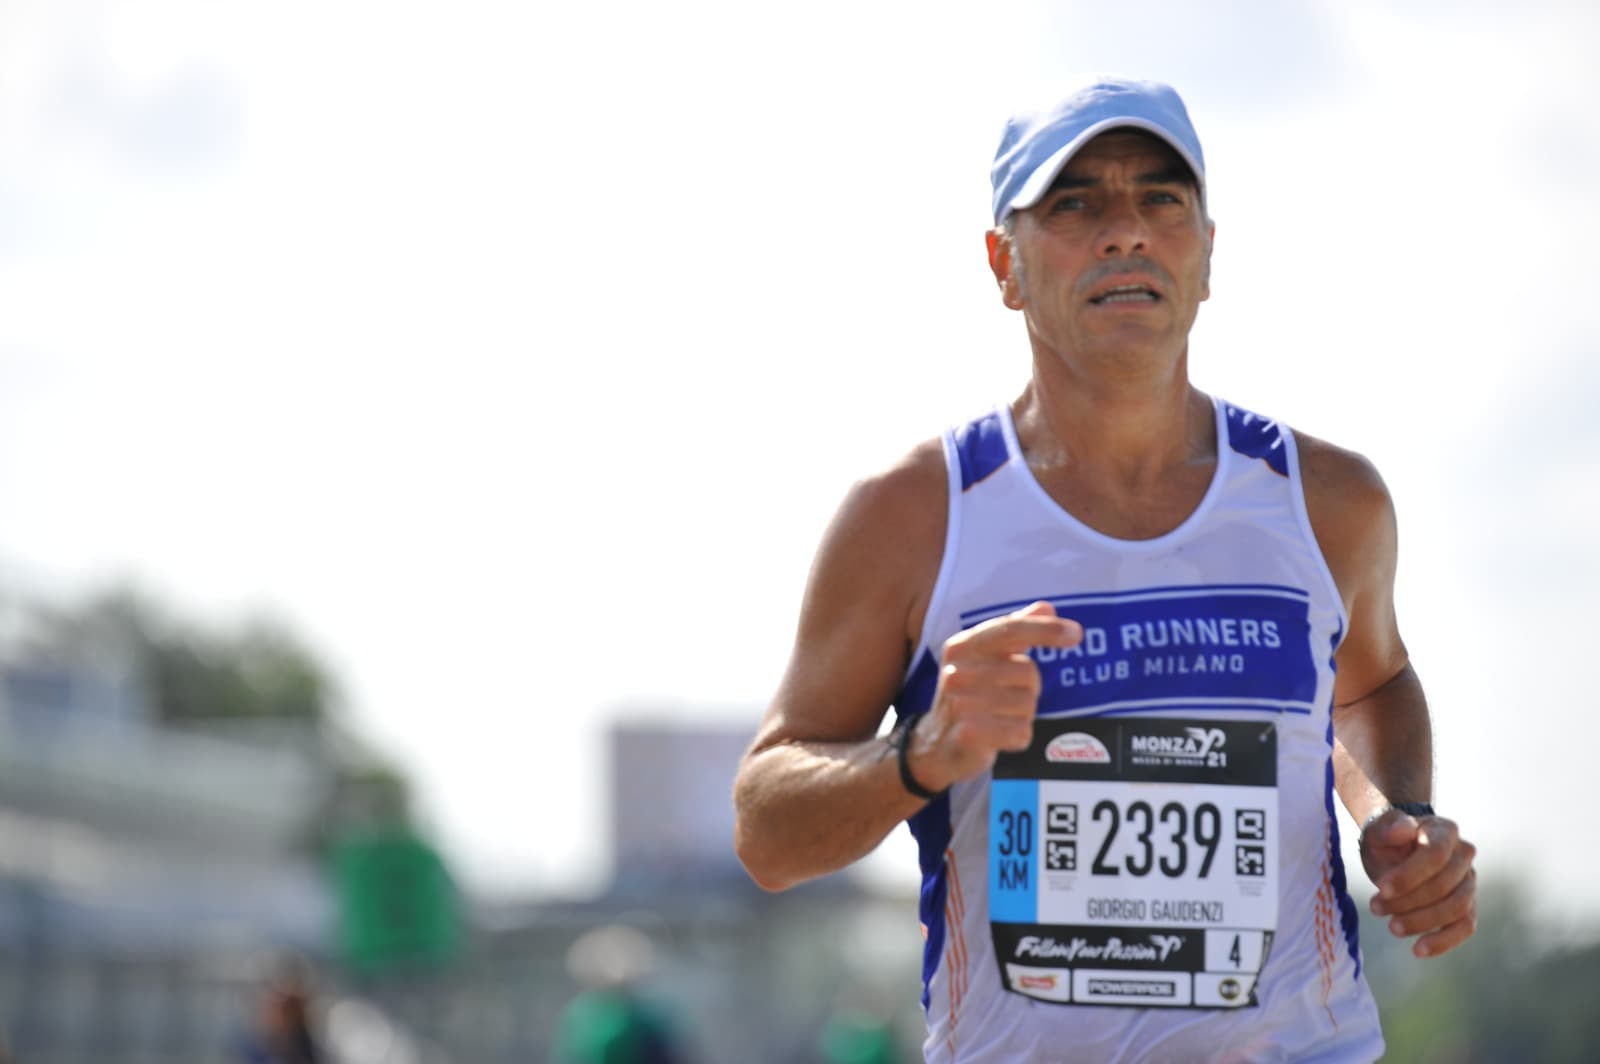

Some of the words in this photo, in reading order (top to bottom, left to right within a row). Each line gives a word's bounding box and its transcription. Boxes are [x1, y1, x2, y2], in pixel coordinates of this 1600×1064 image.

[1121, 618, 1281, 650] RUNNERS
[1060, 661, 1130, 687] CLUB
[1144, 655, 1245, 675] MILANO
[1131, 736, 1196, 753] MONZA
[1207, 752, 1227, 767] 21
[999, 810, 1032, 856] 30
[1091, 799, 1222, 879] 2339
[999, 859, 1028, 890] KM
[1087, 898, 1146, 920] GIORGIO
[1152, 901, 1223, 923] GAUDENZI
[1228, 933, 1242, 968] 4
